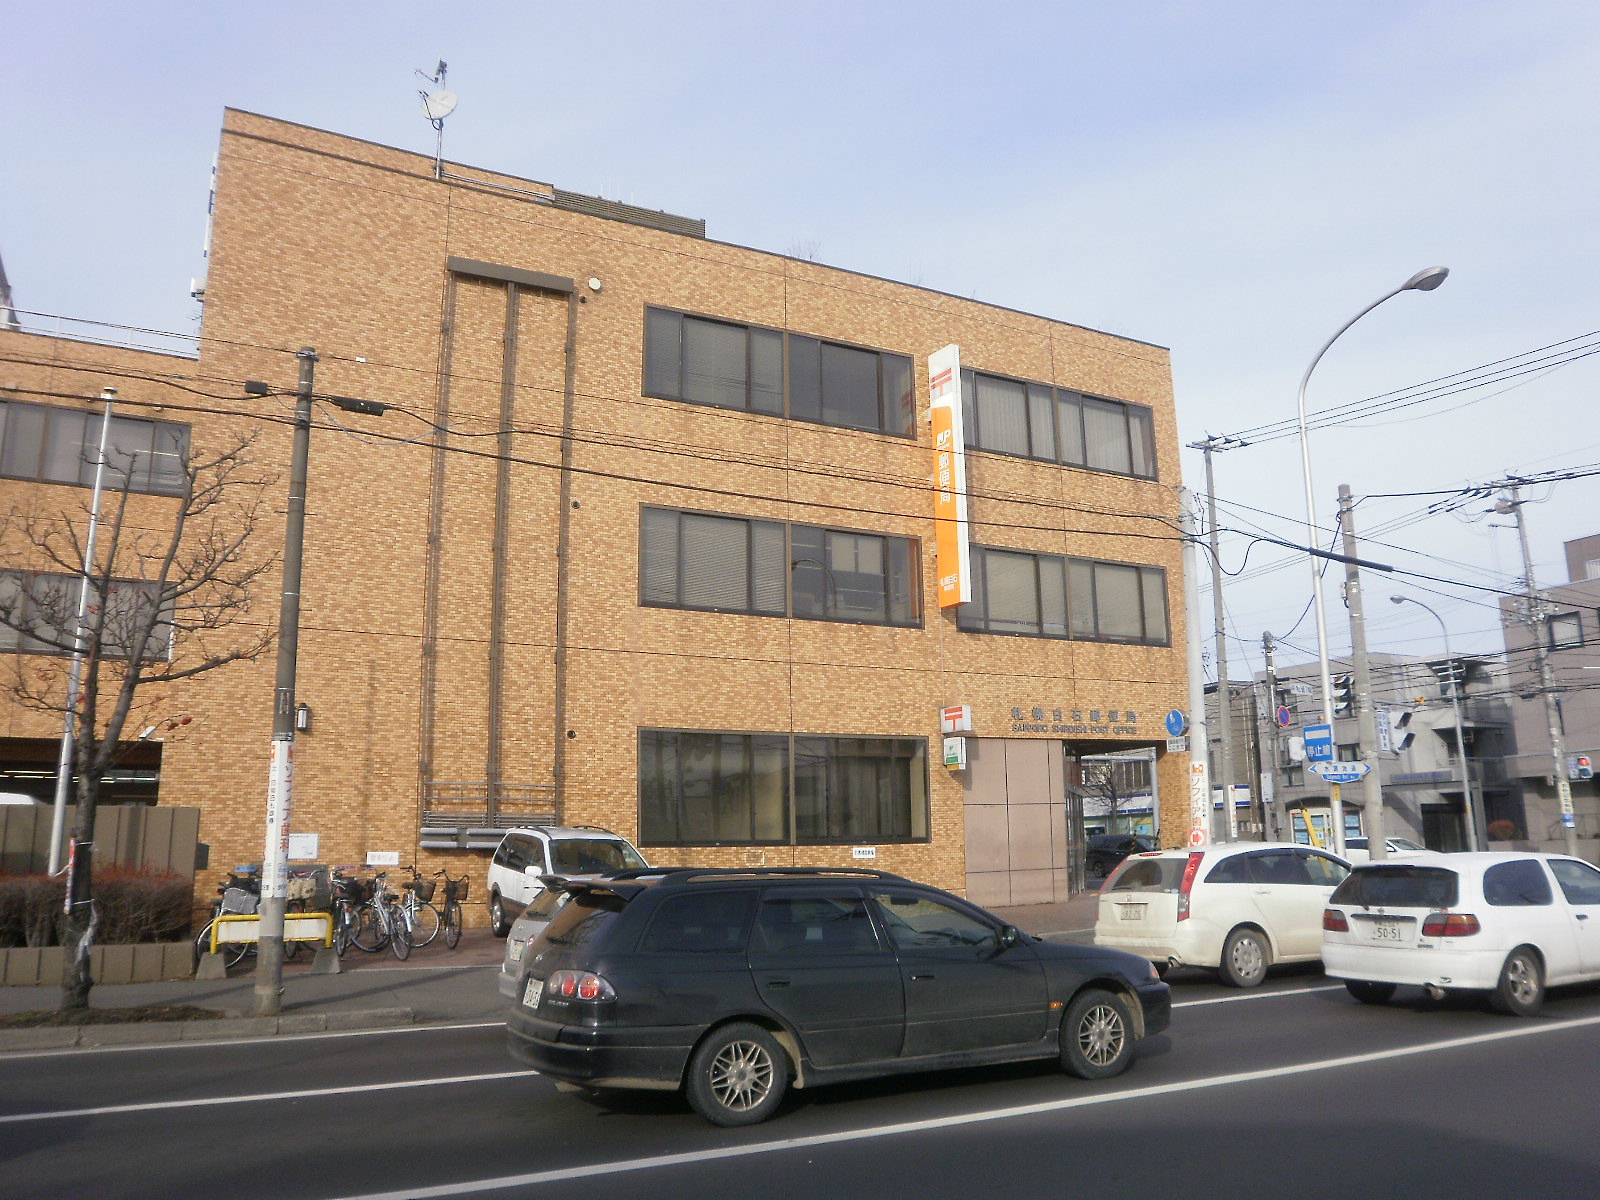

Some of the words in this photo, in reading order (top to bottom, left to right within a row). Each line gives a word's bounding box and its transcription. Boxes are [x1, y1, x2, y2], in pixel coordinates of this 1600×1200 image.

[939, 453, 951, 504] 郵便局
[1011, 706, 1136, 723] 札幌白石郵便局
[1012, 723, 1048, 733] SAPPORO
[1052, 724, 1088, 734] SHIROISHI
[1091, 725, 1109, 734] POST
[1113, 726, 1137, 735] OFFICE
